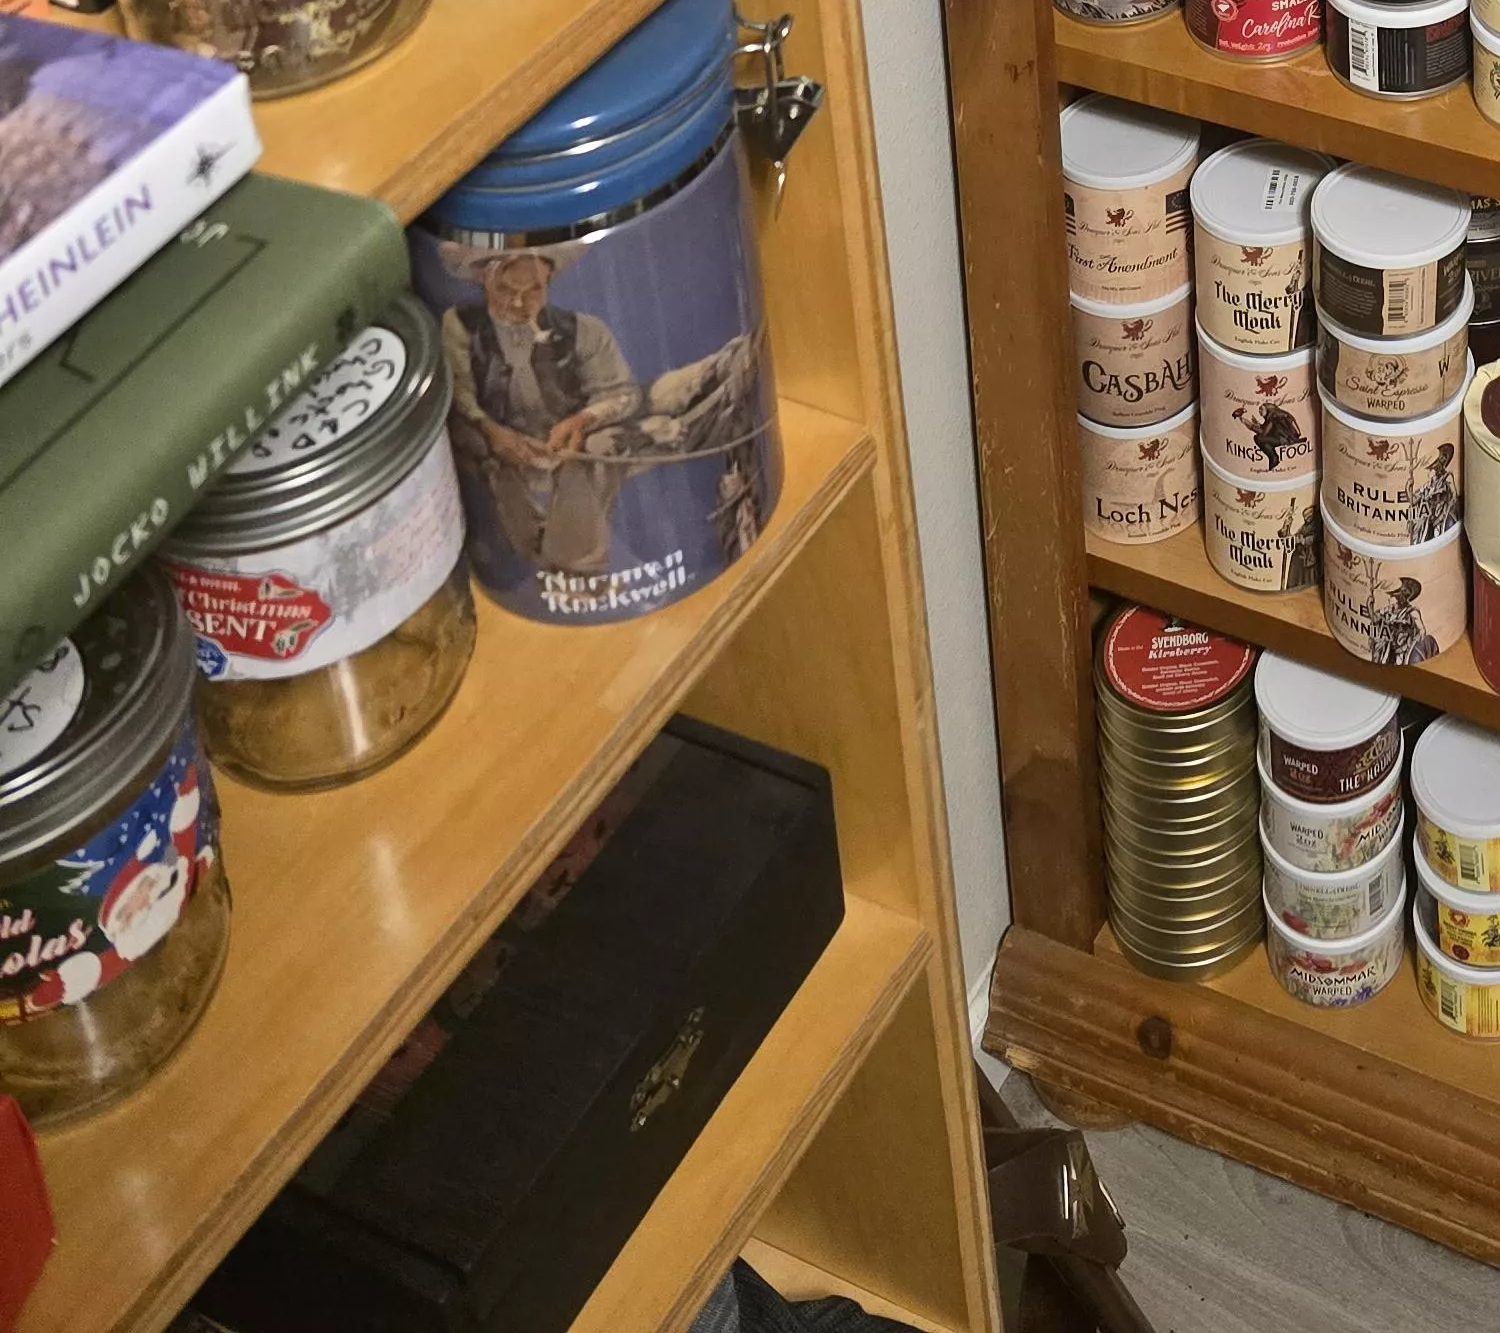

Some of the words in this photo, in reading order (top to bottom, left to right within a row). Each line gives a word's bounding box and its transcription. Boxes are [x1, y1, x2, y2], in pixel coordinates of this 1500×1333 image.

[1242, 13, 1306, 38] Carolina
[0, 185, 154, 325] HEINLEIN
[1068, 243, 1095, 269] First
[1097, 247, 1178, 273] Amendment
[1214, 280, 1240, 307] The
[1246, 289, 1303, 312] Merry
[1233, 309, 1282, 334] Monk
[1082, 352, 1193, 402] CASBAH
[1346, 376, 1379, 395] Saint
[1367, 398, 1405, 411] WARPED
[1226, 438, 1263, 462] KING'S
[1279, 442, 1313, 462] FOOL
[72, 498, 170, 609] JOCKO
[187, 340, 320, 490] WILLINK
[1337, 487, 1430, 521] BRITANNIA
[1353, 481, 1409, 504] RULE
[1096, 497, 1151, 525] Loch
[1214, 514, 1236, 540] The
[1240, 532, 1296, 553] Merry
[1230, 544, 1274, 571] Monk
[186, 610, 277, 641] SENT
[1148, 645, 1212, 659] Kirsberry
[1152, 633, 1209, 649] SVENDBORG
[1284, 754, 1318, 775] WARPED
[1340, 773, 1360, 793] THE
[1290, 821, 1324, 840] WARPED
[1291, 966, 1377, 987] MIDSOMMAR
[1312, 984, 1352, 997] WARPED
